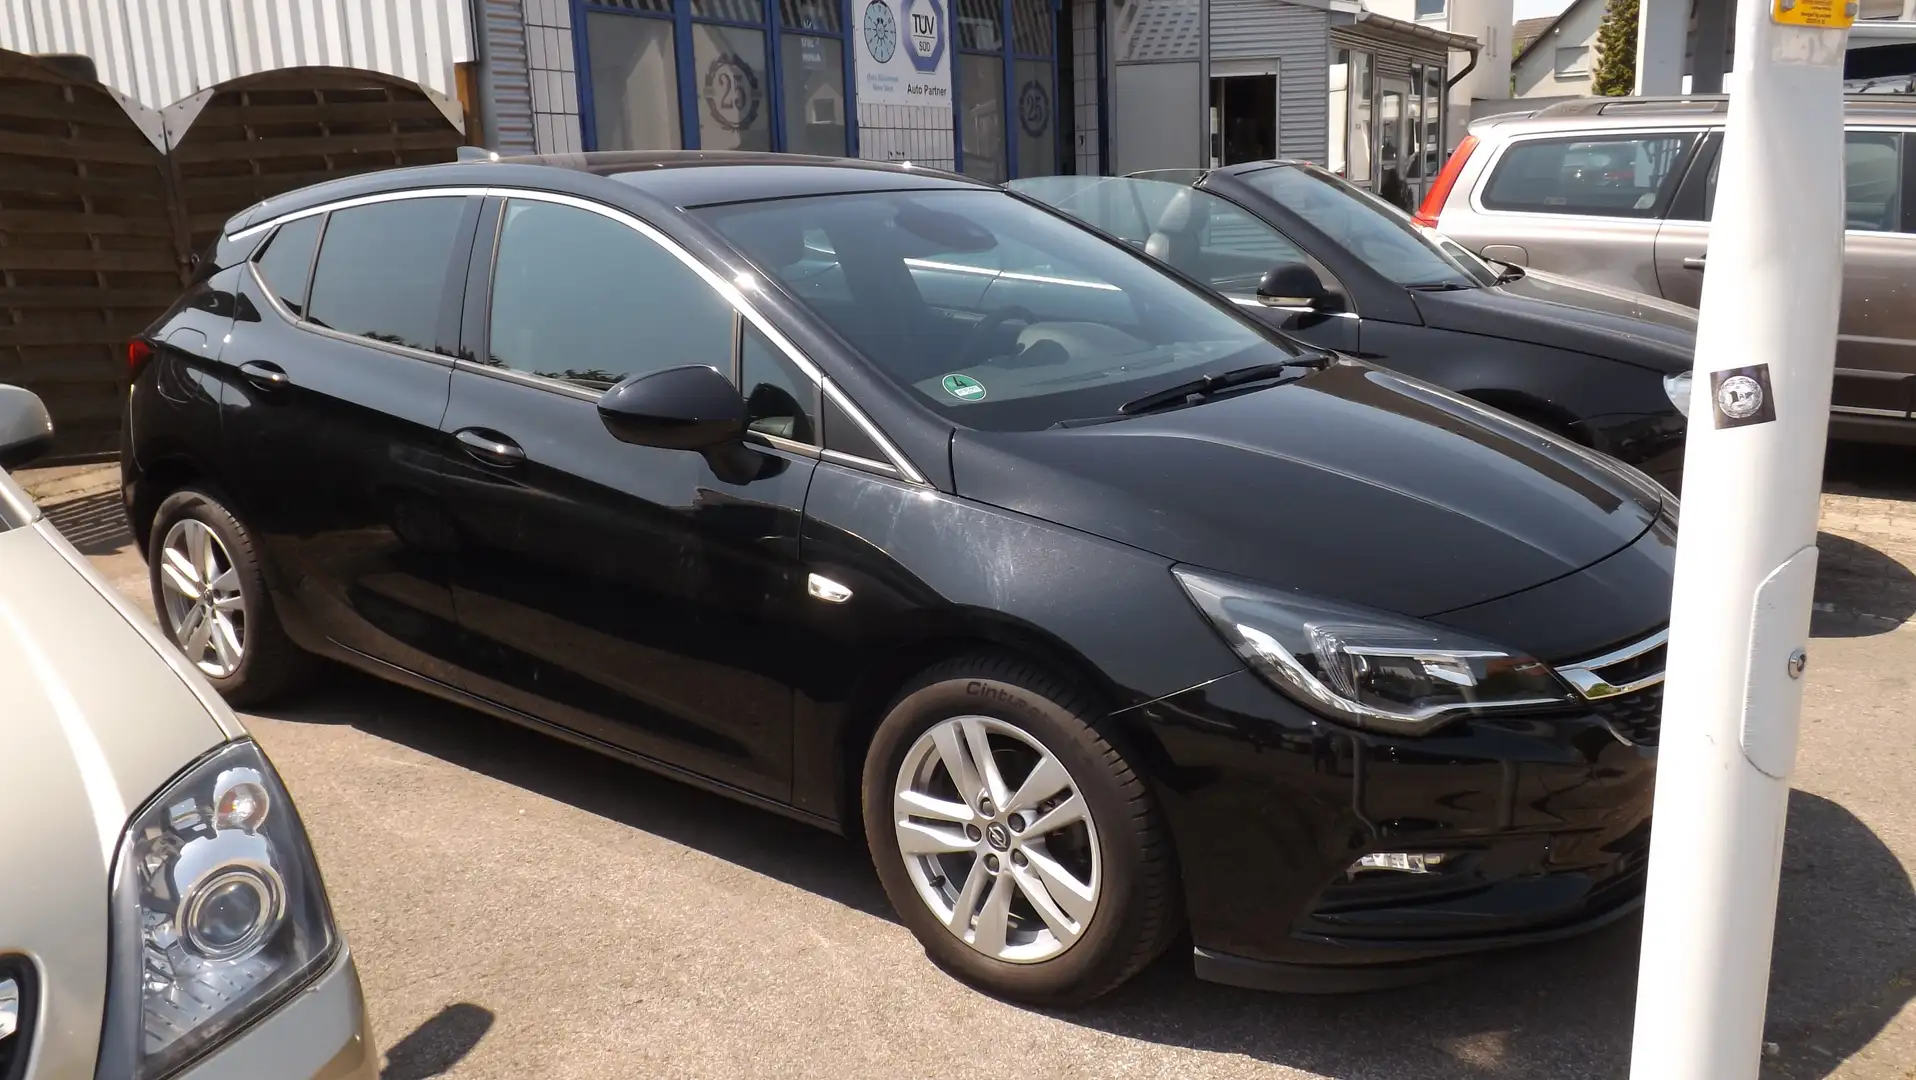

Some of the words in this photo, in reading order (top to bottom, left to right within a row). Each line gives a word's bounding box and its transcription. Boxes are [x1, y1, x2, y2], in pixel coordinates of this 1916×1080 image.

[912, 13, 935, 35] TÜV
[918, 41, 931, 52] SÜD
[718, 73, 747, 110] 25
[907, 83, 922, 95] Auto
[924, 84, 947, 96] Partner
[953, 376, 967, 387] 4
